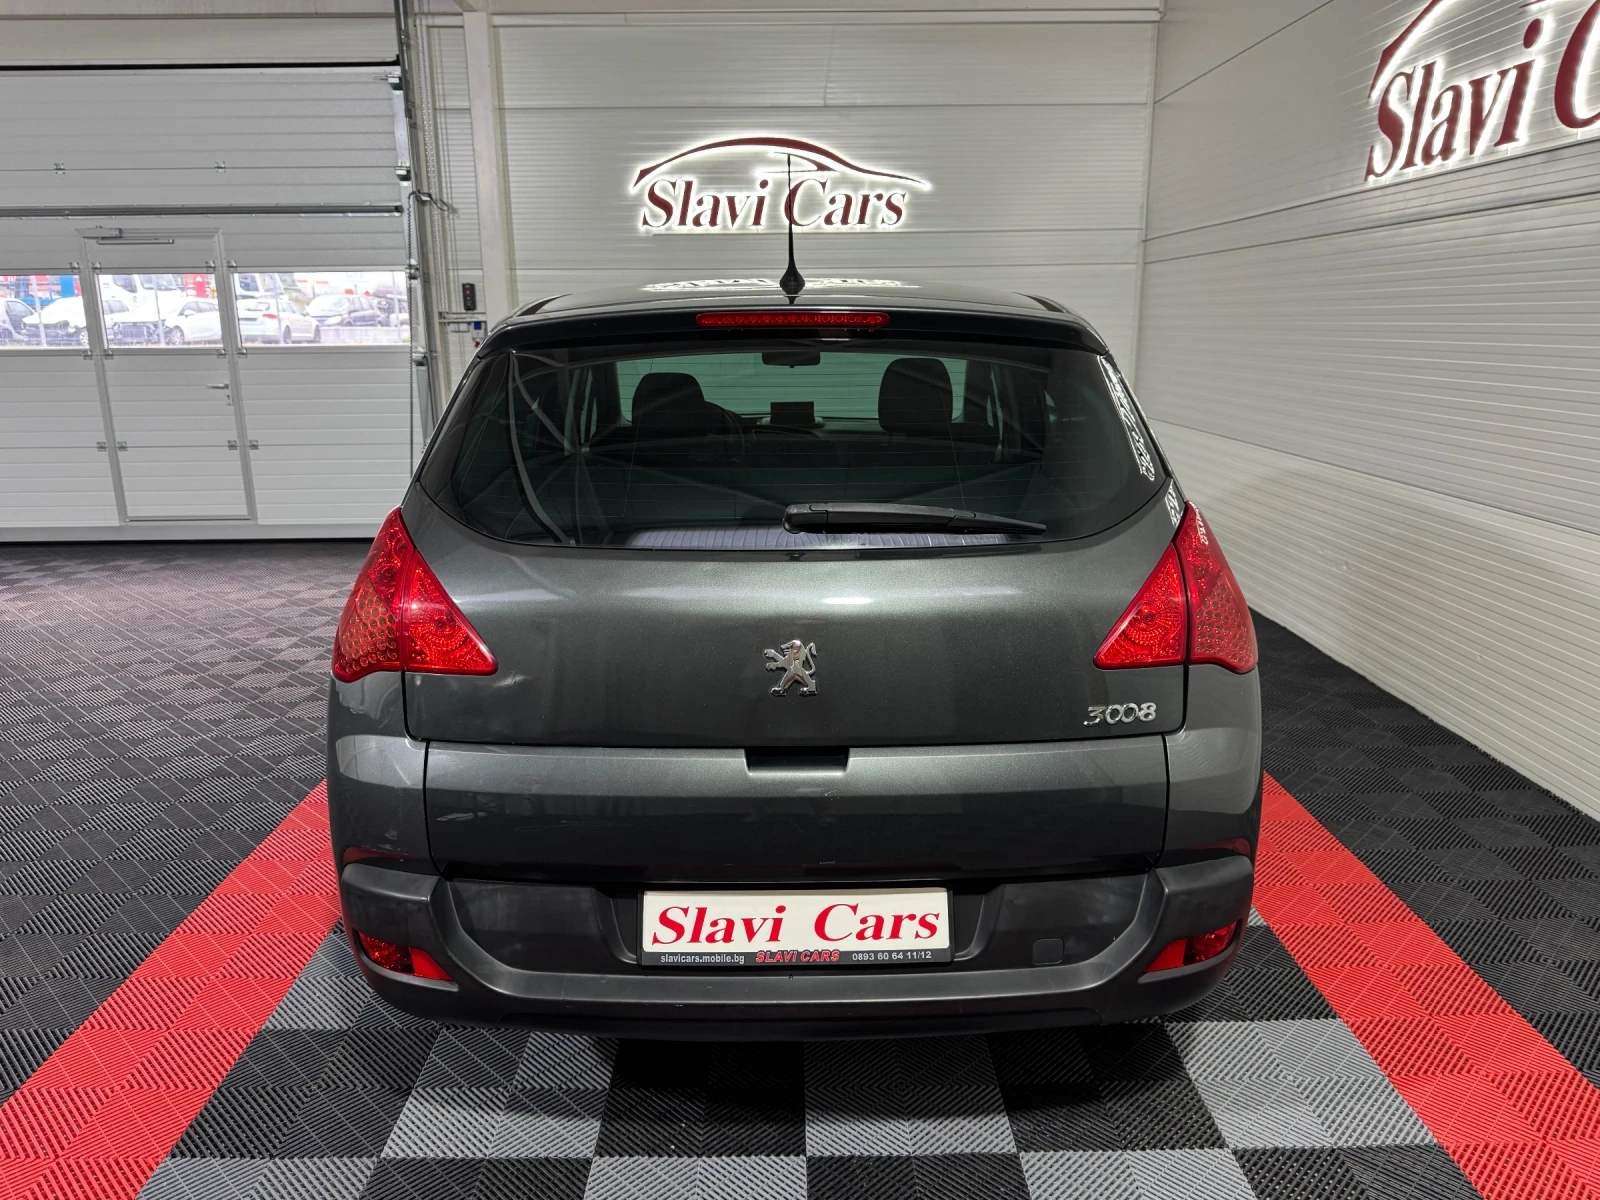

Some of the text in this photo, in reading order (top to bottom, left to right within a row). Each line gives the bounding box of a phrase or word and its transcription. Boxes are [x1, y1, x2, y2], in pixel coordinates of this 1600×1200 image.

[1364, 18, 1543, 182] Slavi
[641, 177, 907, 228] Slavi Cars
[1083, 702, 1157, 726] 3008
[651, 902, 941, 946] Slavi Cars
[660, 953, 745, 965] slavicars.mobile.bg
[755, 949, 841, 964] SLAVI CARS
[852, 950, 932, 961] 0893 60 64 11/12
